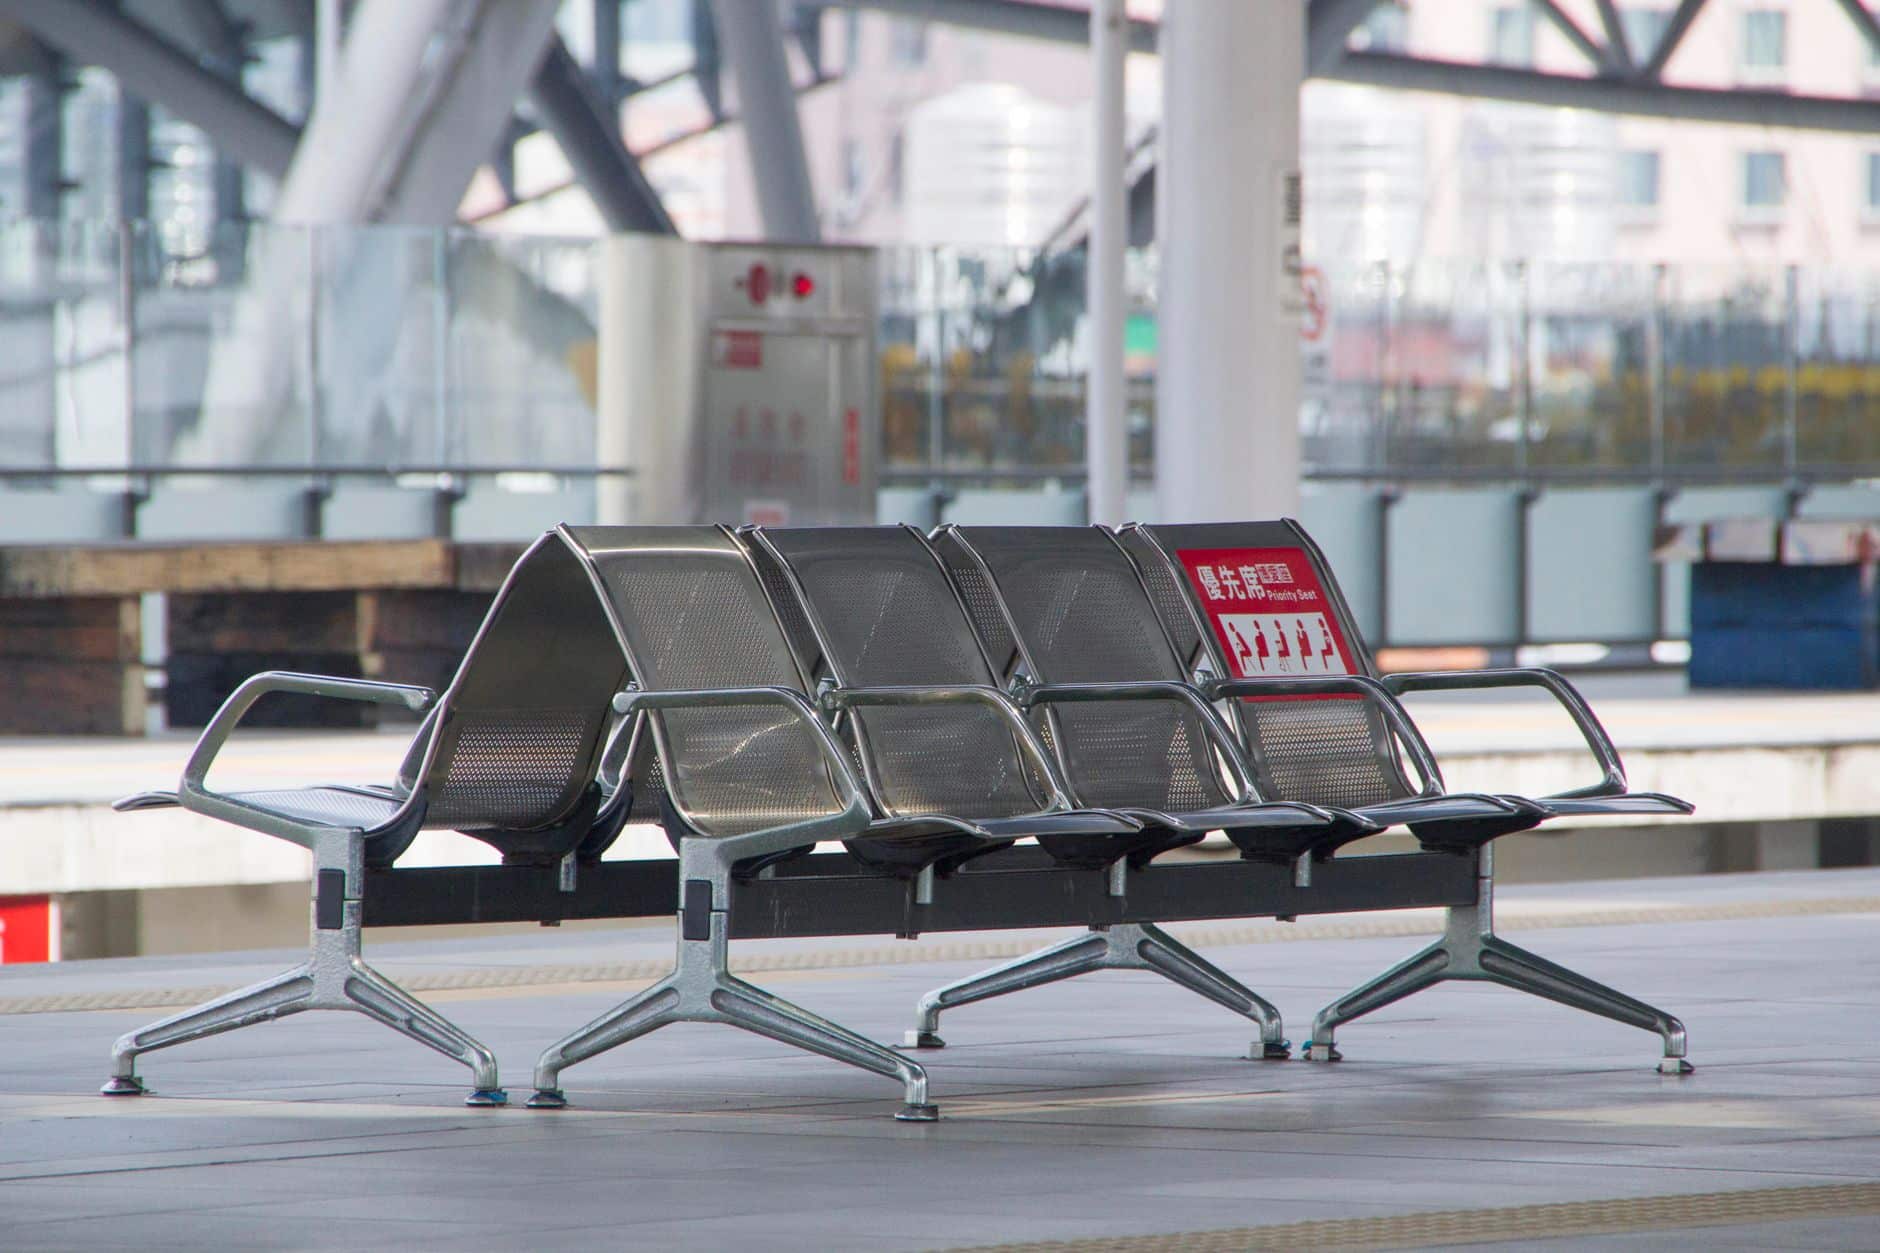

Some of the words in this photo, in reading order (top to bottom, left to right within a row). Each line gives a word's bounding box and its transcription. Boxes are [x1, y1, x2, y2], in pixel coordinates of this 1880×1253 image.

[1196, 565, 1265, 600] 優先席
[1266, 589, 1298, 602] Priority
[1296, 588, 1317, 600] Seat
